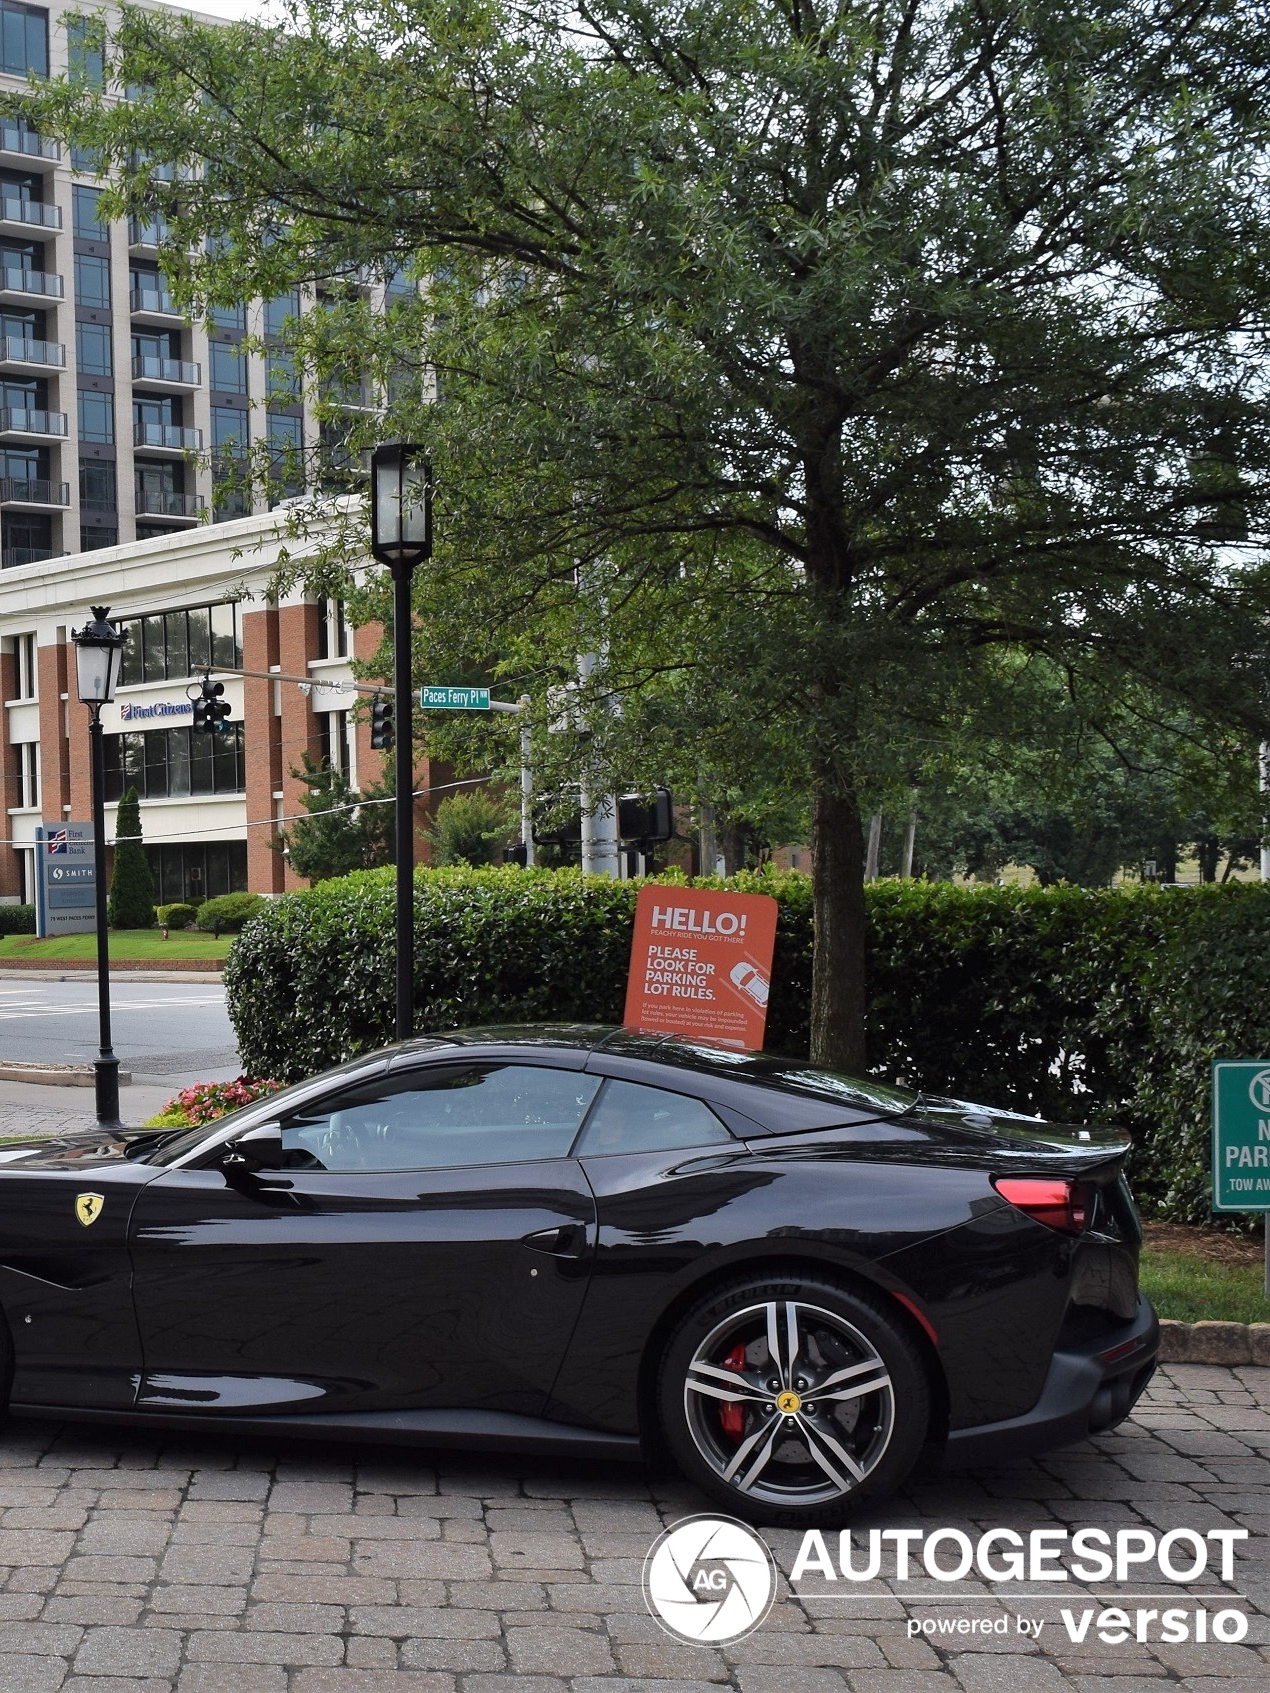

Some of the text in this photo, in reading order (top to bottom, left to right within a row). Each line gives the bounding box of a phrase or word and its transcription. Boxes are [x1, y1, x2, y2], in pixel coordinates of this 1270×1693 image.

[424, 689, 446, 703] Paces
[448, 690, 468, 706] Ferry
[471, 690, 478, 703] Pl
[652, 906, 747, 936] HELLO!
[651, 929, 677, 937] PEACHY
[723, 936, 744, 944] THERE
[648, 945, 697, 960] PLEASE
[647, 958, 715, 975] LOOK FOR
[646, 970, 706, 986] PARKING
[644, 983, 716, 1000] LOT RULES.
[678, 1012, 697, 1020] vehicle
[718, 1017, 747, 1025] impounded
[723, 1011, 744, 1019] parking
[1226, 1146, 1270, 1167] PAR
[1229, 1178, 1253, 1190] TOW
